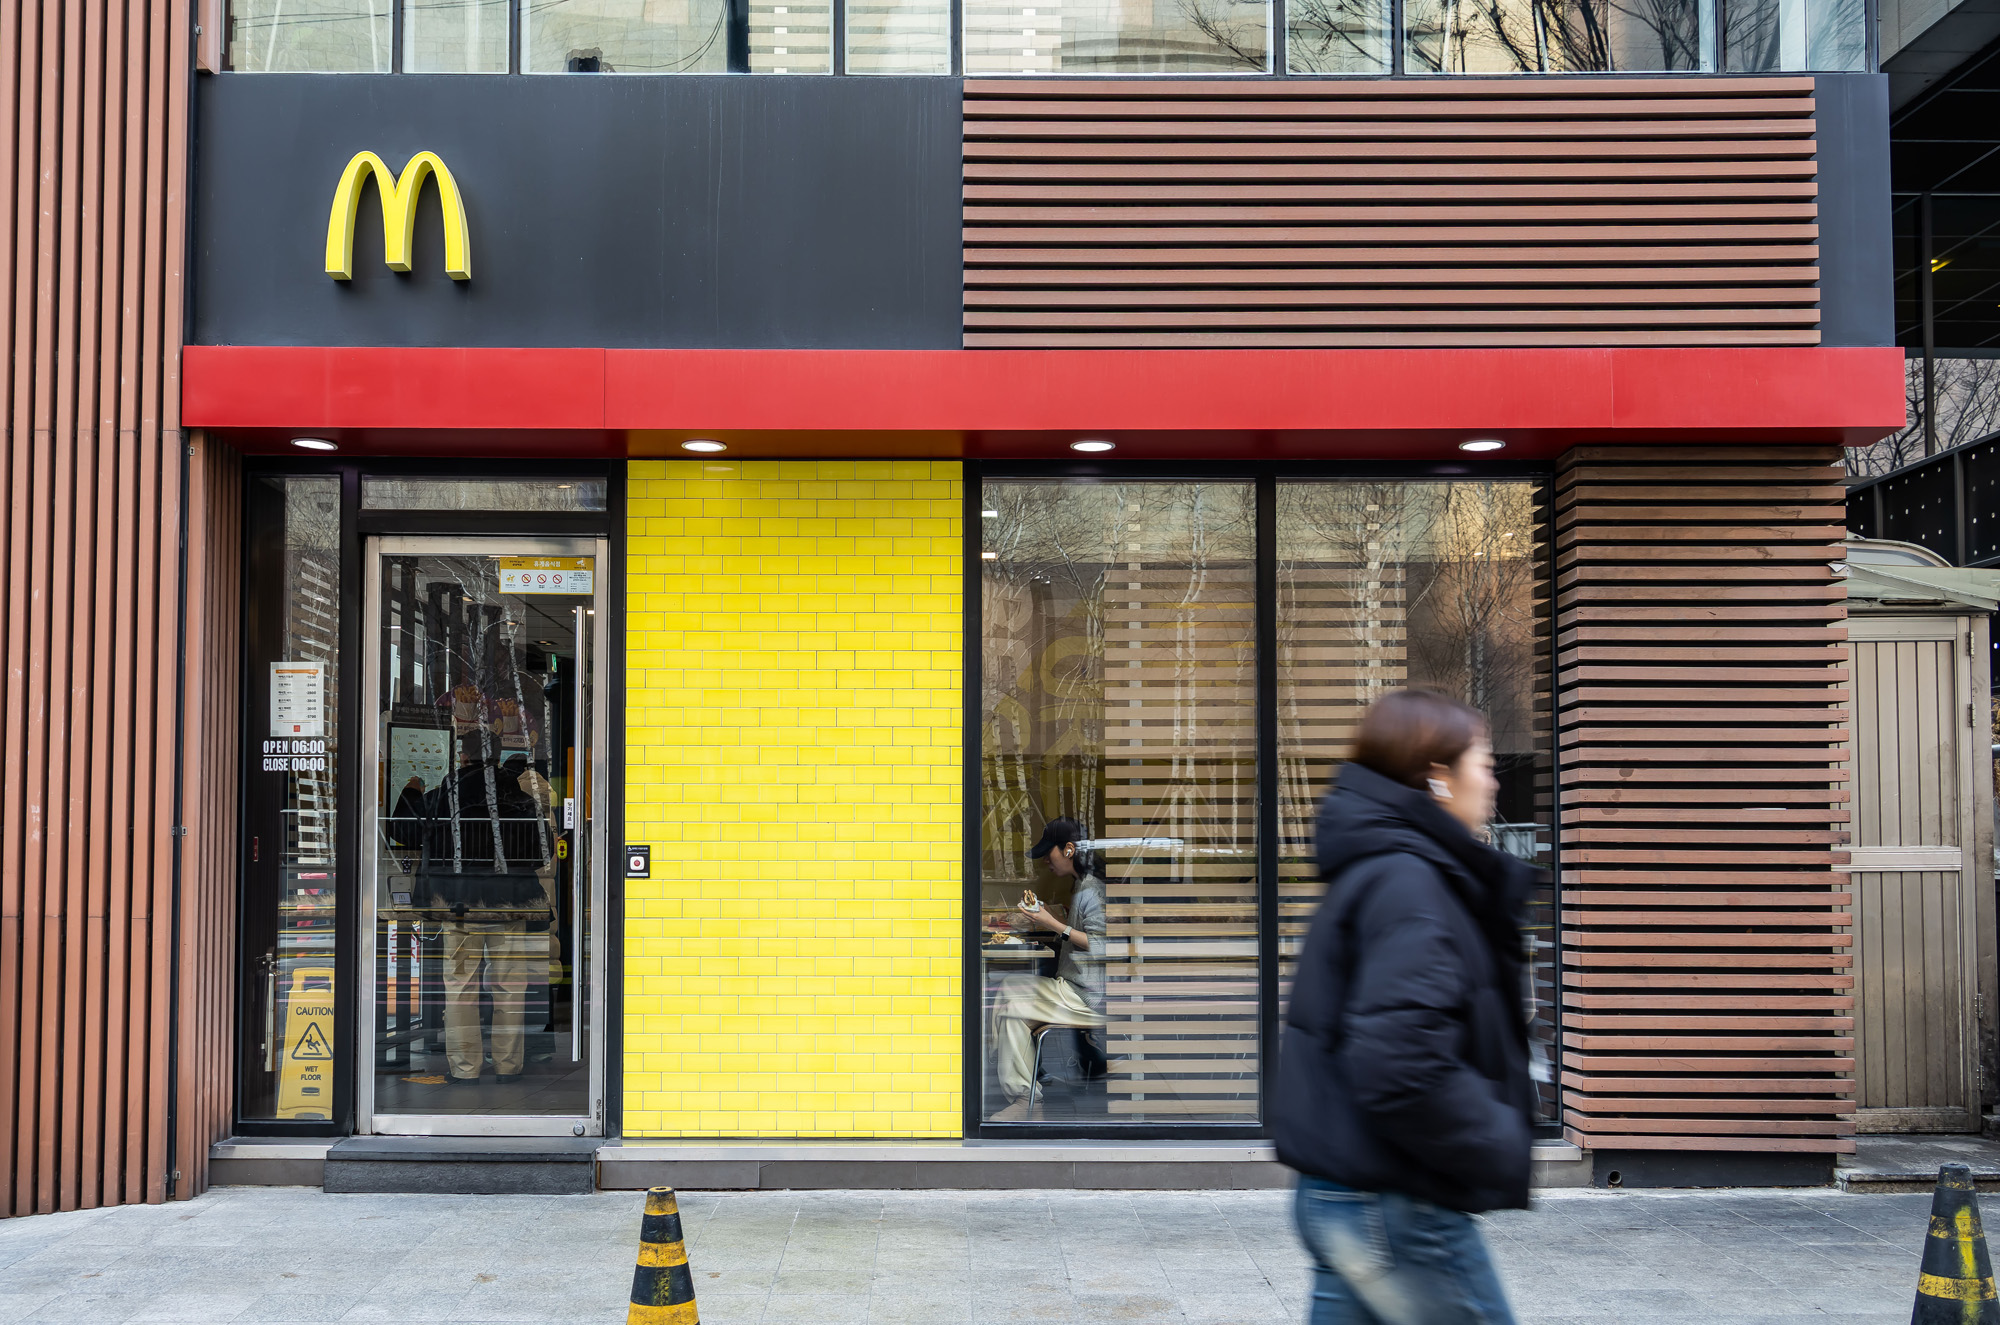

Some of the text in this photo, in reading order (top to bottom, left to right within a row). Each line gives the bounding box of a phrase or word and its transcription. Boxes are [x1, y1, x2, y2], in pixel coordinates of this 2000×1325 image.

[533, 560, 561, 568] 휴게음식점
[263, 740, 325, 754] OPEN 06:00
[263, 758, 325, 772] CLOSE 00:00
[296, 1006, 334, 1016] CAUTION
